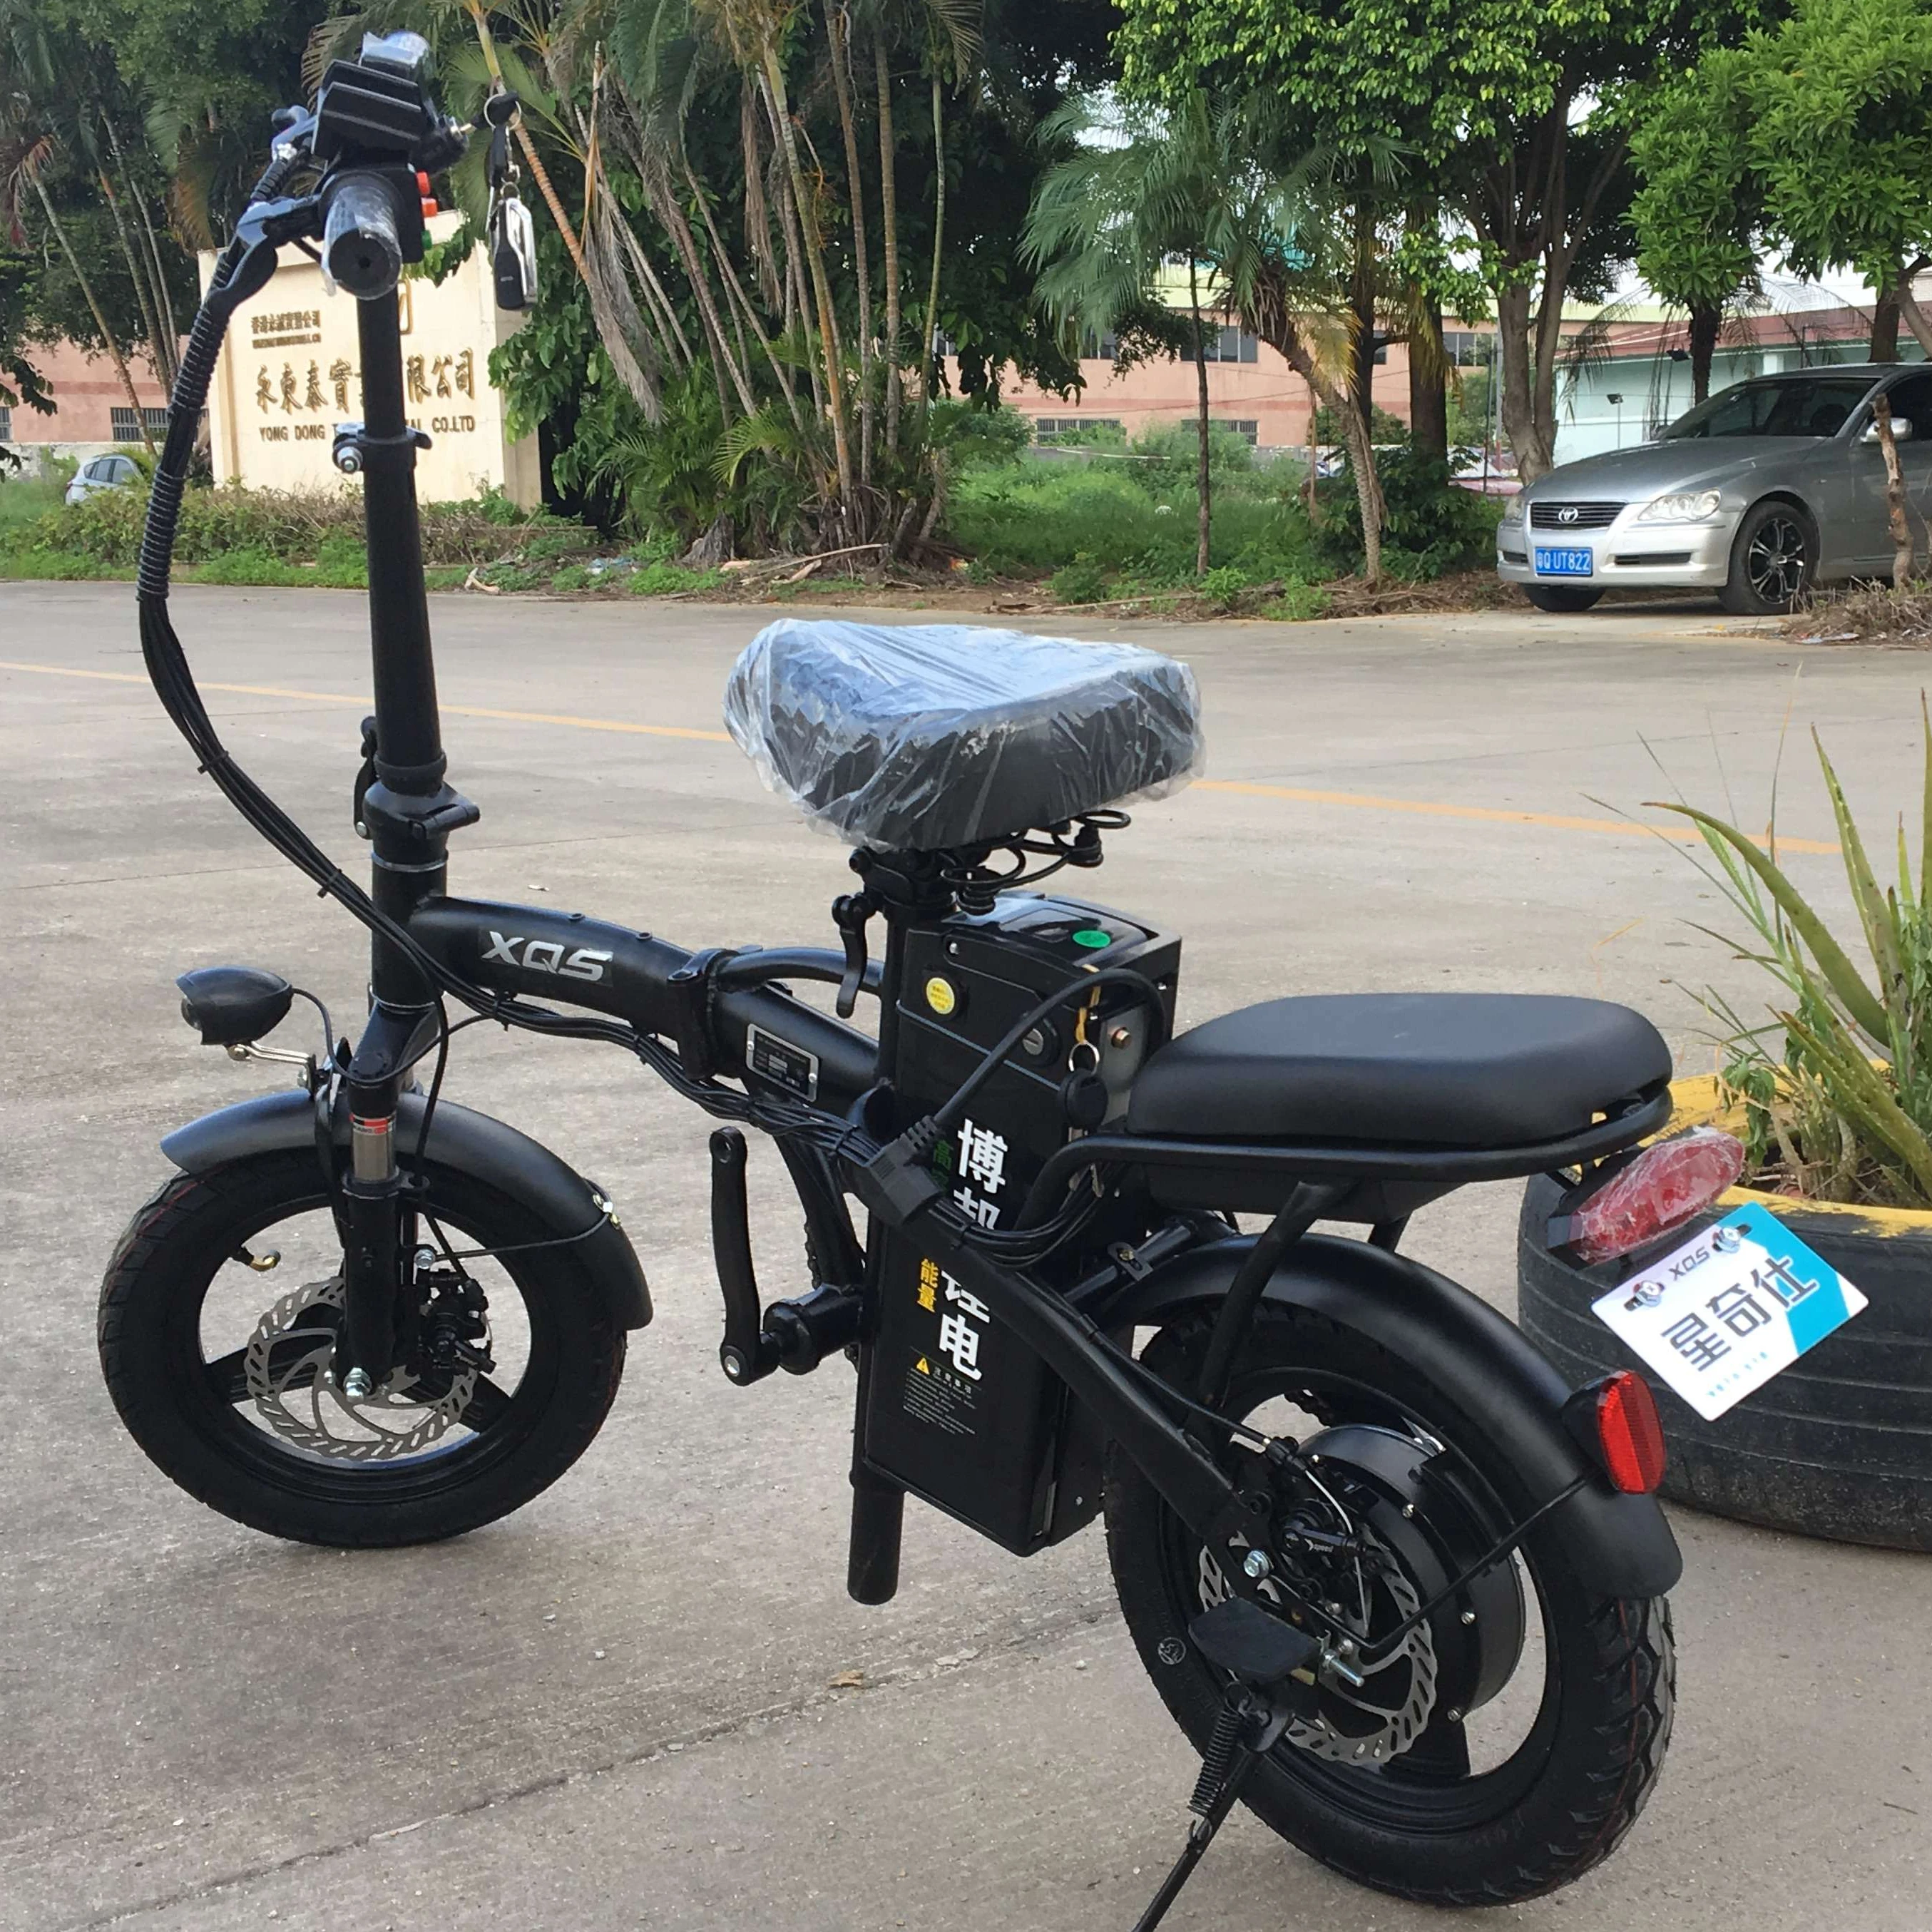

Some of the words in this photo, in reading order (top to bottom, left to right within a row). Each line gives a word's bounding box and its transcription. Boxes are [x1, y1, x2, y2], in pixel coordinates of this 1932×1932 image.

[259, 426, 289, 442] YONG
[294, 424, 326, 440] DONG
[480, 931, 614, 983] XQS
[917, 1257, 939, 1313] 能量
[1667, 1246, 1711, 1282] XQS
[1660, 1257, 1819, 1372] 星奇仕
